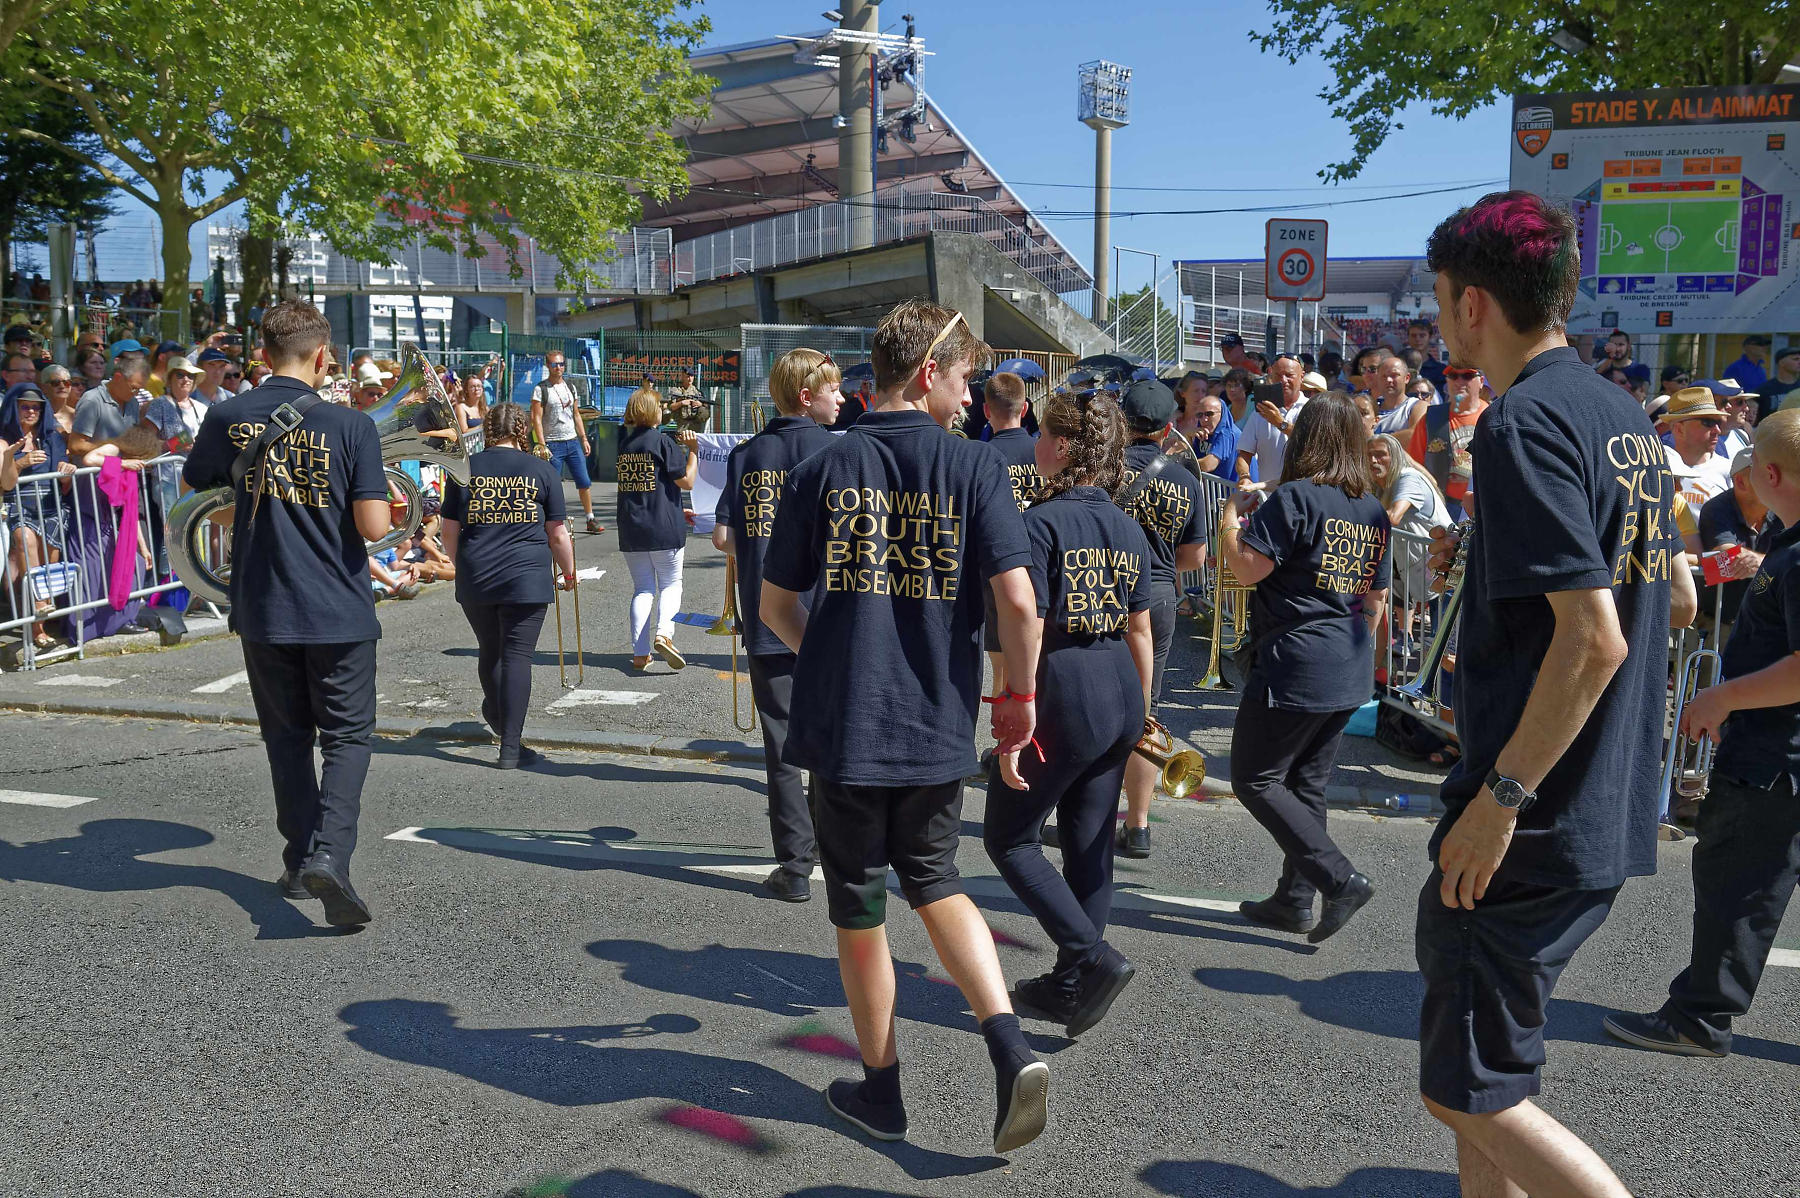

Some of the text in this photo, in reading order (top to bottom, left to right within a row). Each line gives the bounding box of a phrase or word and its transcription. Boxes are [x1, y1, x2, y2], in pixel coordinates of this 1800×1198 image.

[1571, 94, 1794, 123] STADE Y. ALLAINMAT
[1280, 229, 1316, 241] ZONE
[1285, 259, 1308, 275] 30
[1659, 313, 1670, 326] E
[652, 356, 695, 367] ACCES
[228, 422, 331, 453] CORWALL
[468, 475, 539, 491] CORNWALL
[742, 469, 787, 488] CORN
[468, 487, 538, 500] YOUTH
[468, 498, 537, 511] BRASS
[826, 487, 962, 519] CORNWALL
[467, 511, 538, 524] ENSEMBLE
[829, 513, 961, 546] YOUTH
[826, 540, 960, 572] BRASS
[826, 568, 959, 601] ENSEMBLE
